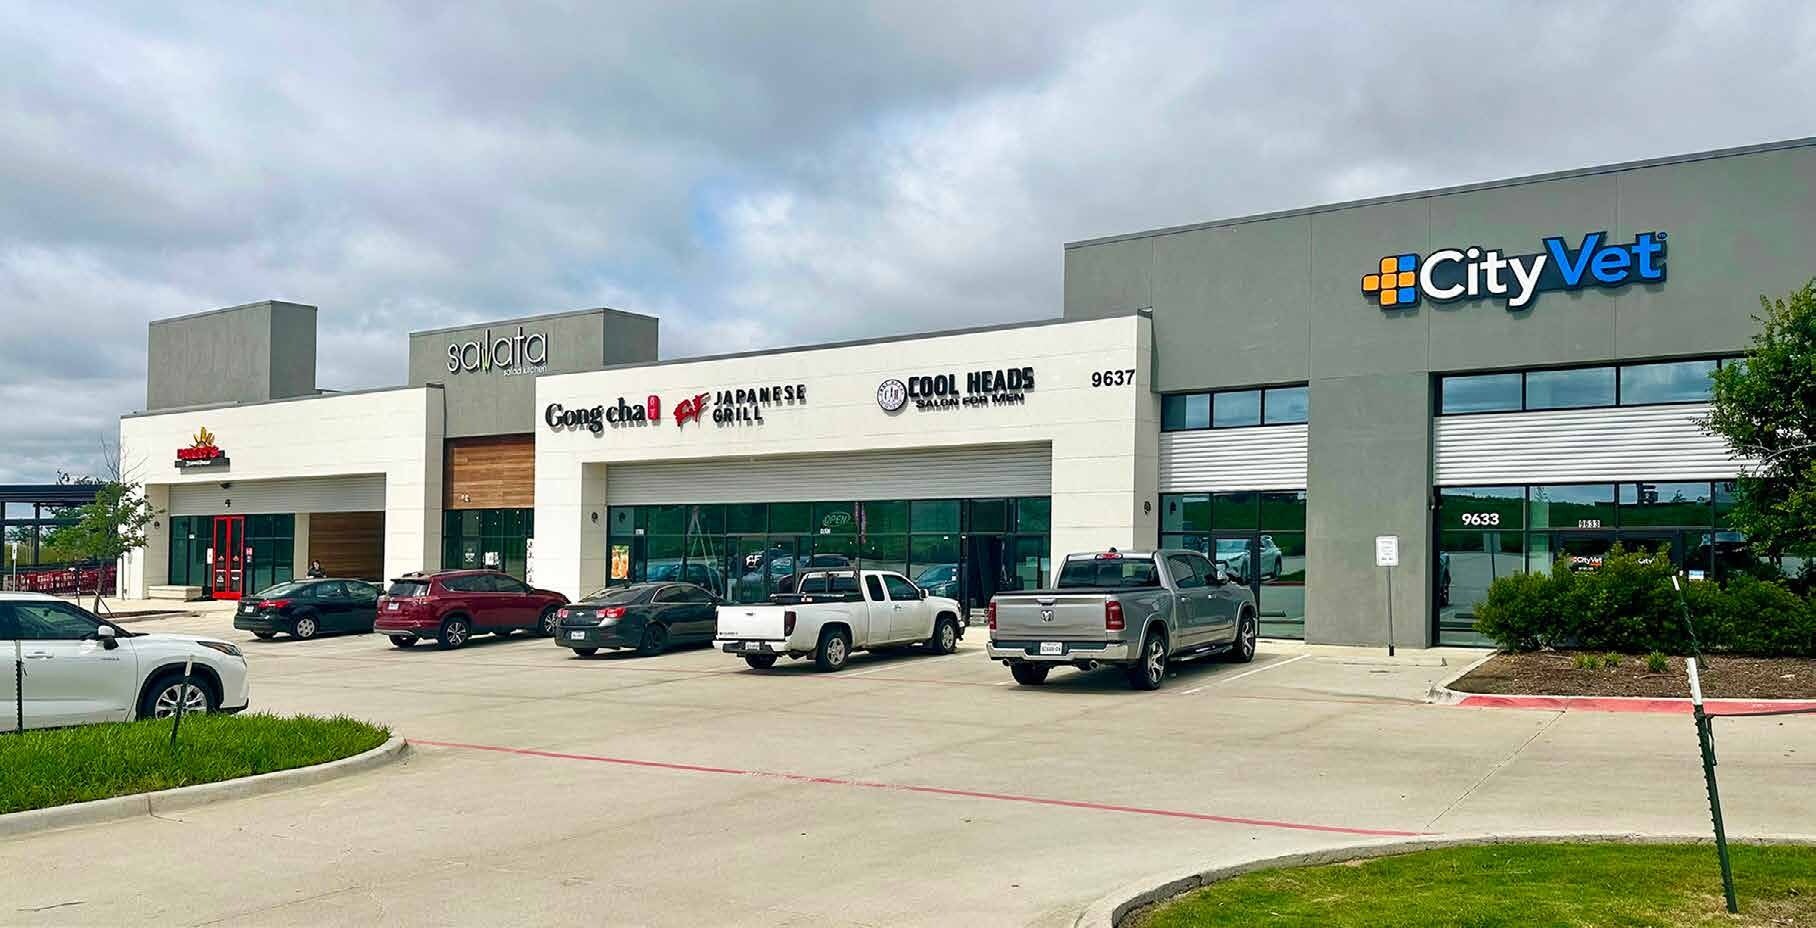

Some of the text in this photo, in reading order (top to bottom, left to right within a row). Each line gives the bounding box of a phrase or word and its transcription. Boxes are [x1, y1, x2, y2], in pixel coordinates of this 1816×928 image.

[1420, 231, 1662, 307] CityVet
[448, 327, 547, 372] salata
[908, 374, 959, 398] COOL
[967, 367, 1034, 393] HEADS
[1091, 369, 1135, 387] 9637
[714, 384, 806, 405] JAPANESE
[916, 393, 1024, 408] SALON FOR MEN
[545, 403, 604, 433] Gong
[606, 397, 646, 423] cha
[713, 406, 763, 423] GRILL
[1461, 513, 1500, 526] 9633
